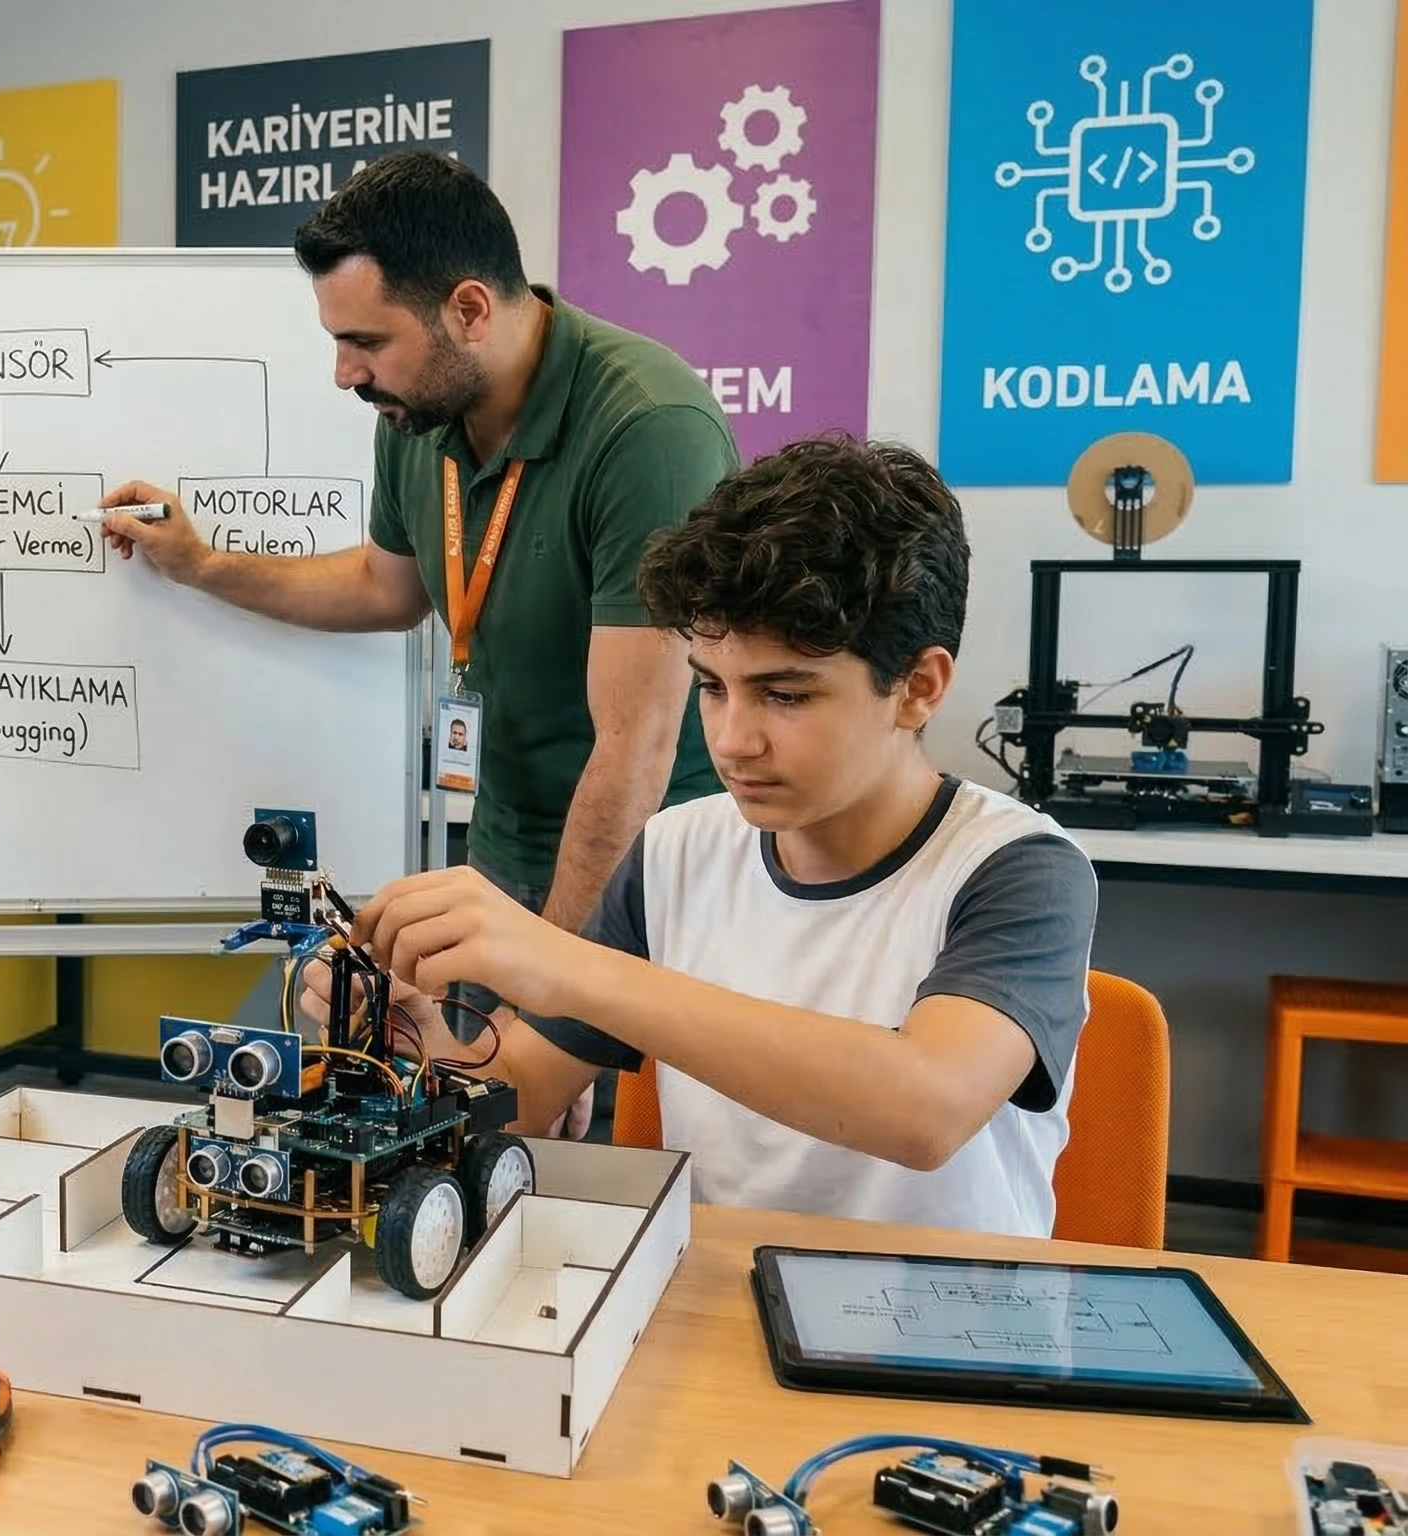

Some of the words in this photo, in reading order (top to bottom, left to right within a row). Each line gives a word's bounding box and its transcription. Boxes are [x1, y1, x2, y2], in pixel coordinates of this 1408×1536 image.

[207, 93, 453, 158] KARİYERİNE
[983, 360, 1252, 409] KODLAMA
[193, 490, 347, 520] MOTORLAR
[13, 526, 94, 563] Verme)
